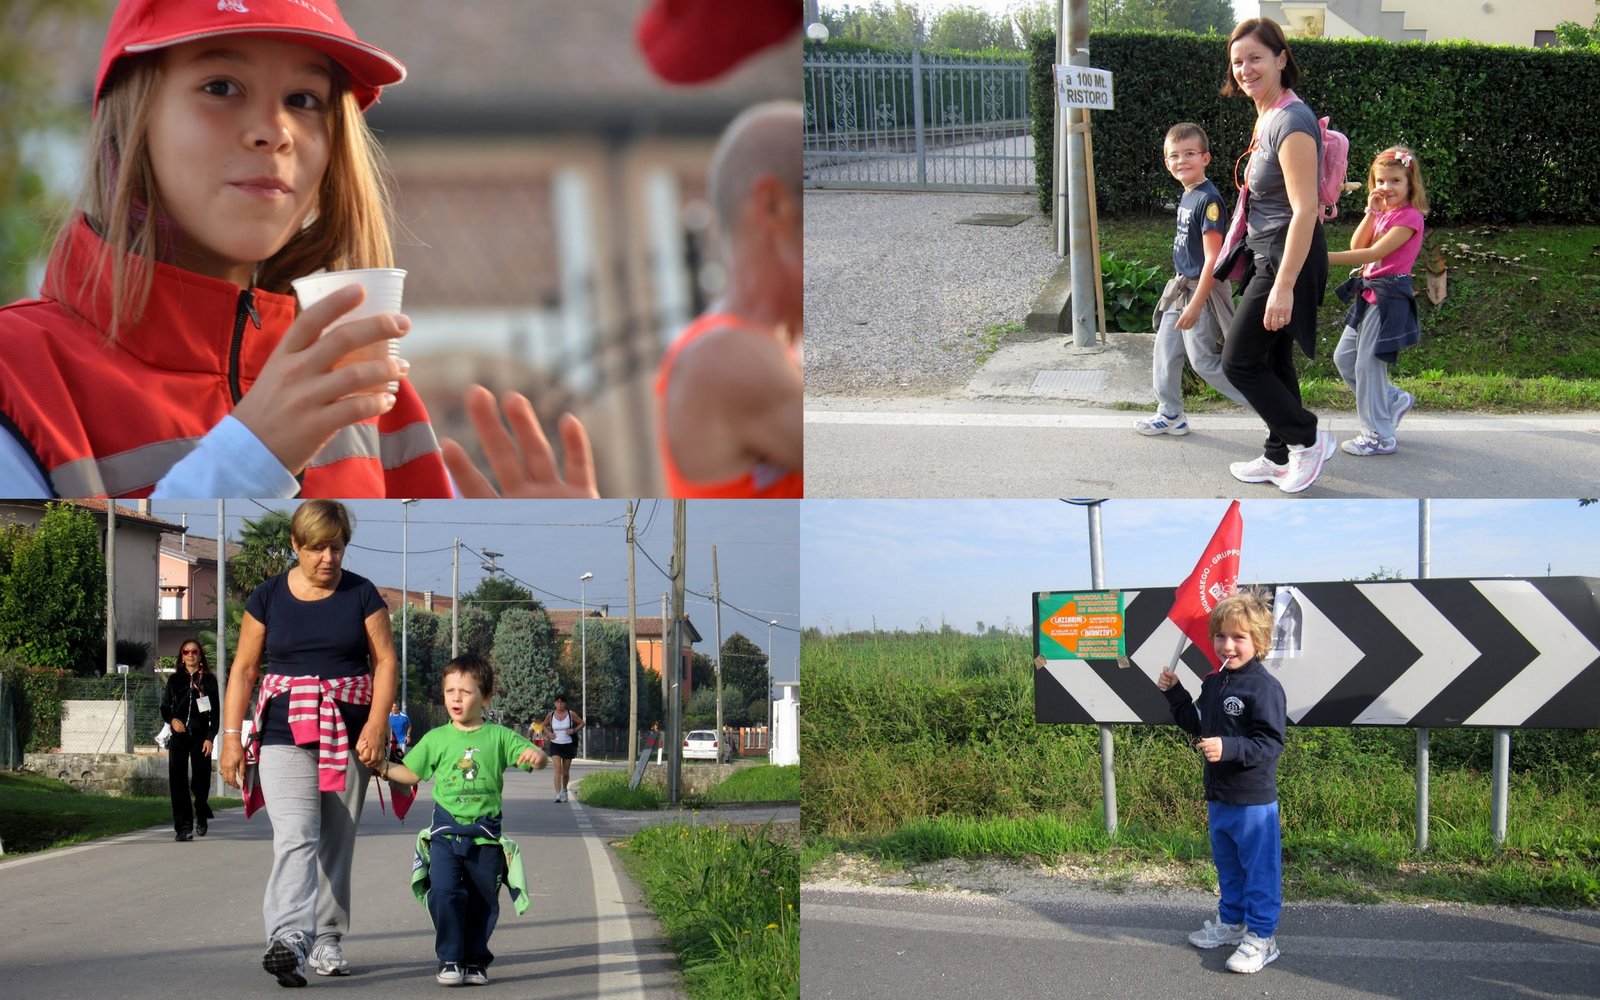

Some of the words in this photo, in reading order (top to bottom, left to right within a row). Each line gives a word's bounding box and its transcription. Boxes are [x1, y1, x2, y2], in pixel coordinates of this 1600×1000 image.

[1066, 75, 1072, 85] a
[1077, 72, 1093, 87] 100
[1094, 74, 1107, 88] Mt.
[1067, 89, 1108, 104] RISTORO
